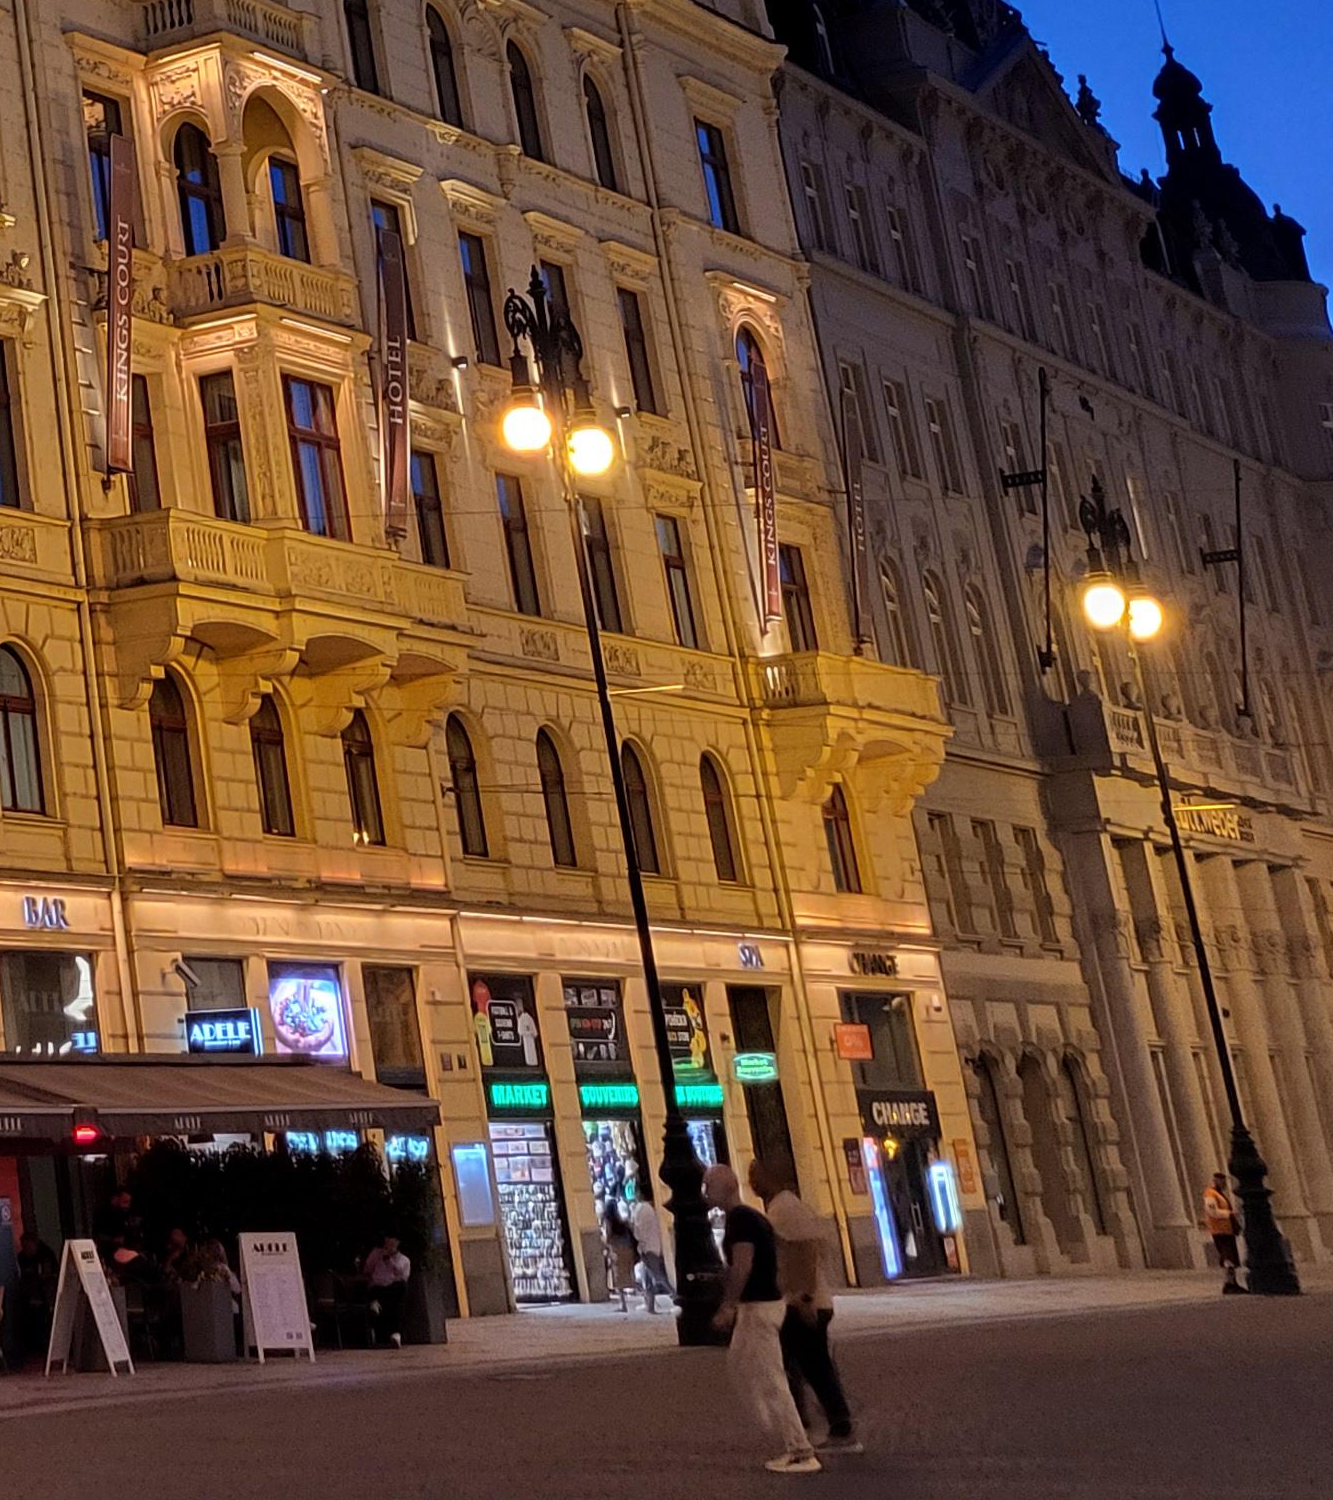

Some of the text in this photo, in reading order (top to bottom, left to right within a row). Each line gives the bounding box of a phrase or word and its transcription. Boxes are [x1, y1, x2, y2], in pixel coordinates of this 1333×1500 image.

[115, 213, 131, 402] KINGS COURT
[388, 335, 404, 425] HOTEL
[759, 425, 776, 565] KINGS COURT
[22, 896, 69, 930] BAR
[847, 951, 900, 977] CHANGE
[190, 1021, 252, 1043] ADELE
[491, 1084, 548, 1107] MARKET
[579, 1085, 640, 1107] SOUVENIRS
[871, 1101, 931, 1125] CHANGE
